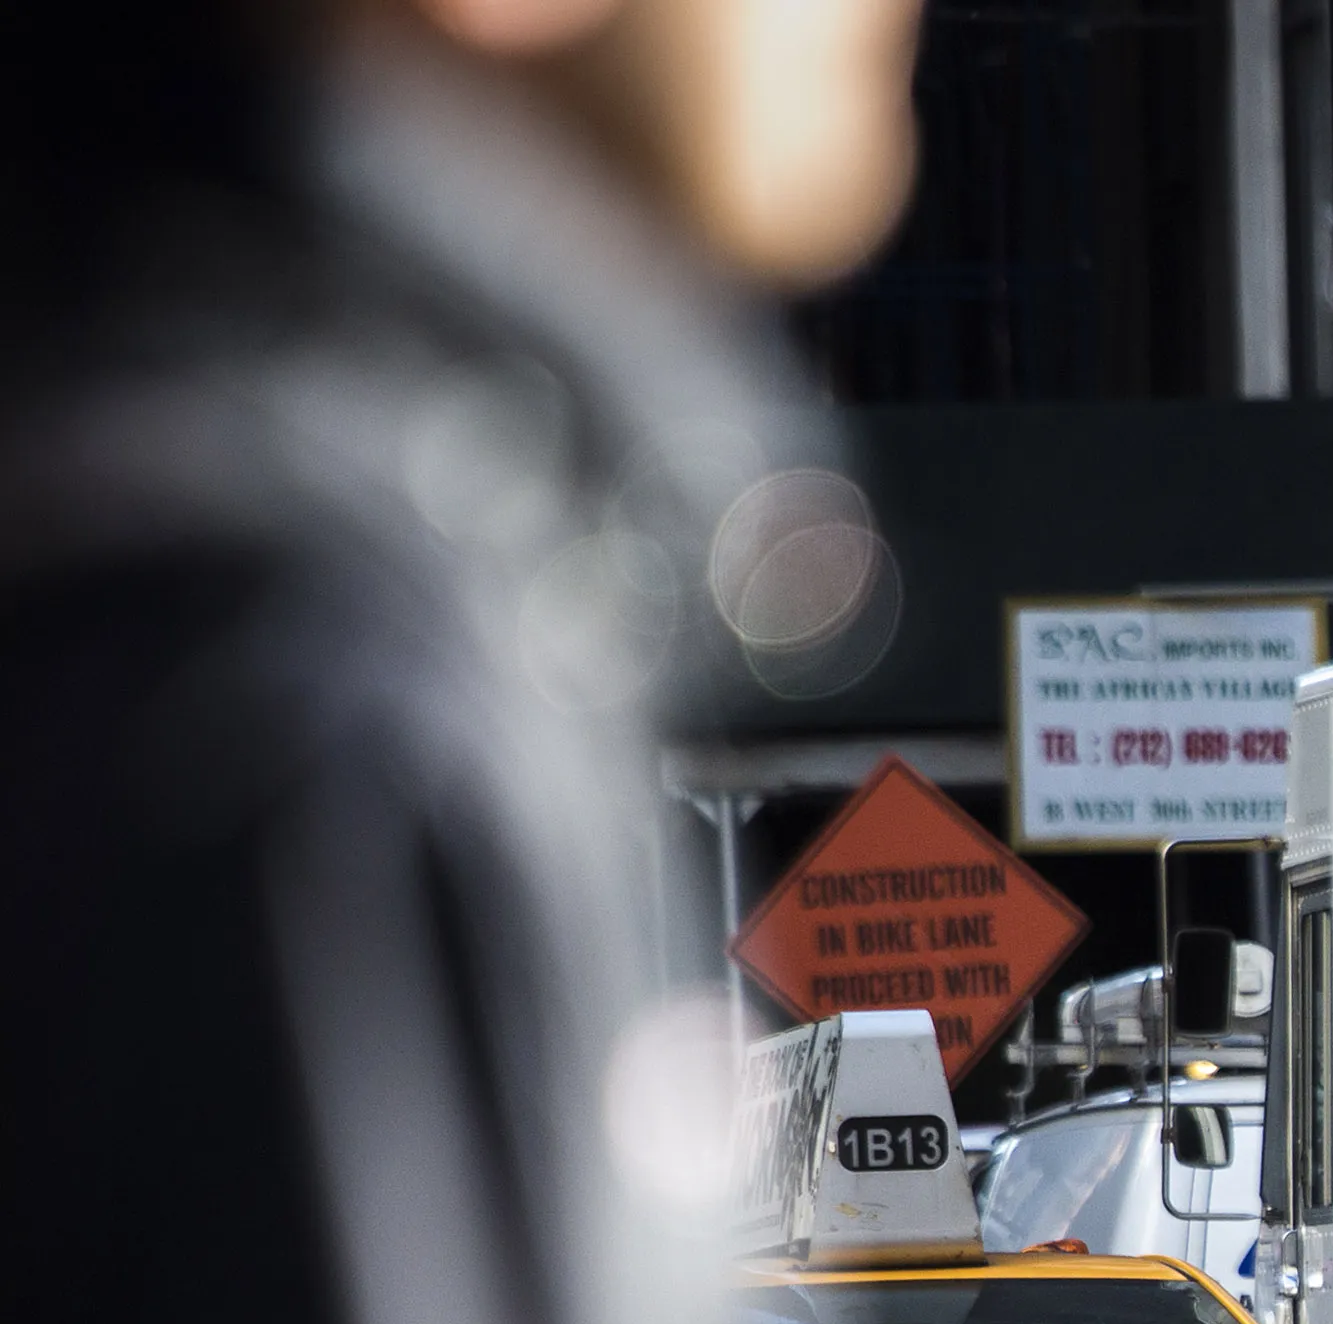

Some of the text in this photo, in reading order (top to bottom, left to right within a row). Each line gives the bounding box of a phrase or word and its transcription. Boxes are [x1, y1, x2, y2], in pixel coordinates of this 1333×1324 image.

[1092, 677, 1192, 700] AFRICAN
[1111, 727, 1172, 769] (212)
[801, 864, 1007, 910] CONSTRUCTION
[818, 911, 997, 956] IN BIKE LANE
[812, 963, 1010, 1008] PROCEED WITH
[844, 1126, 942, 1168] 1B13
